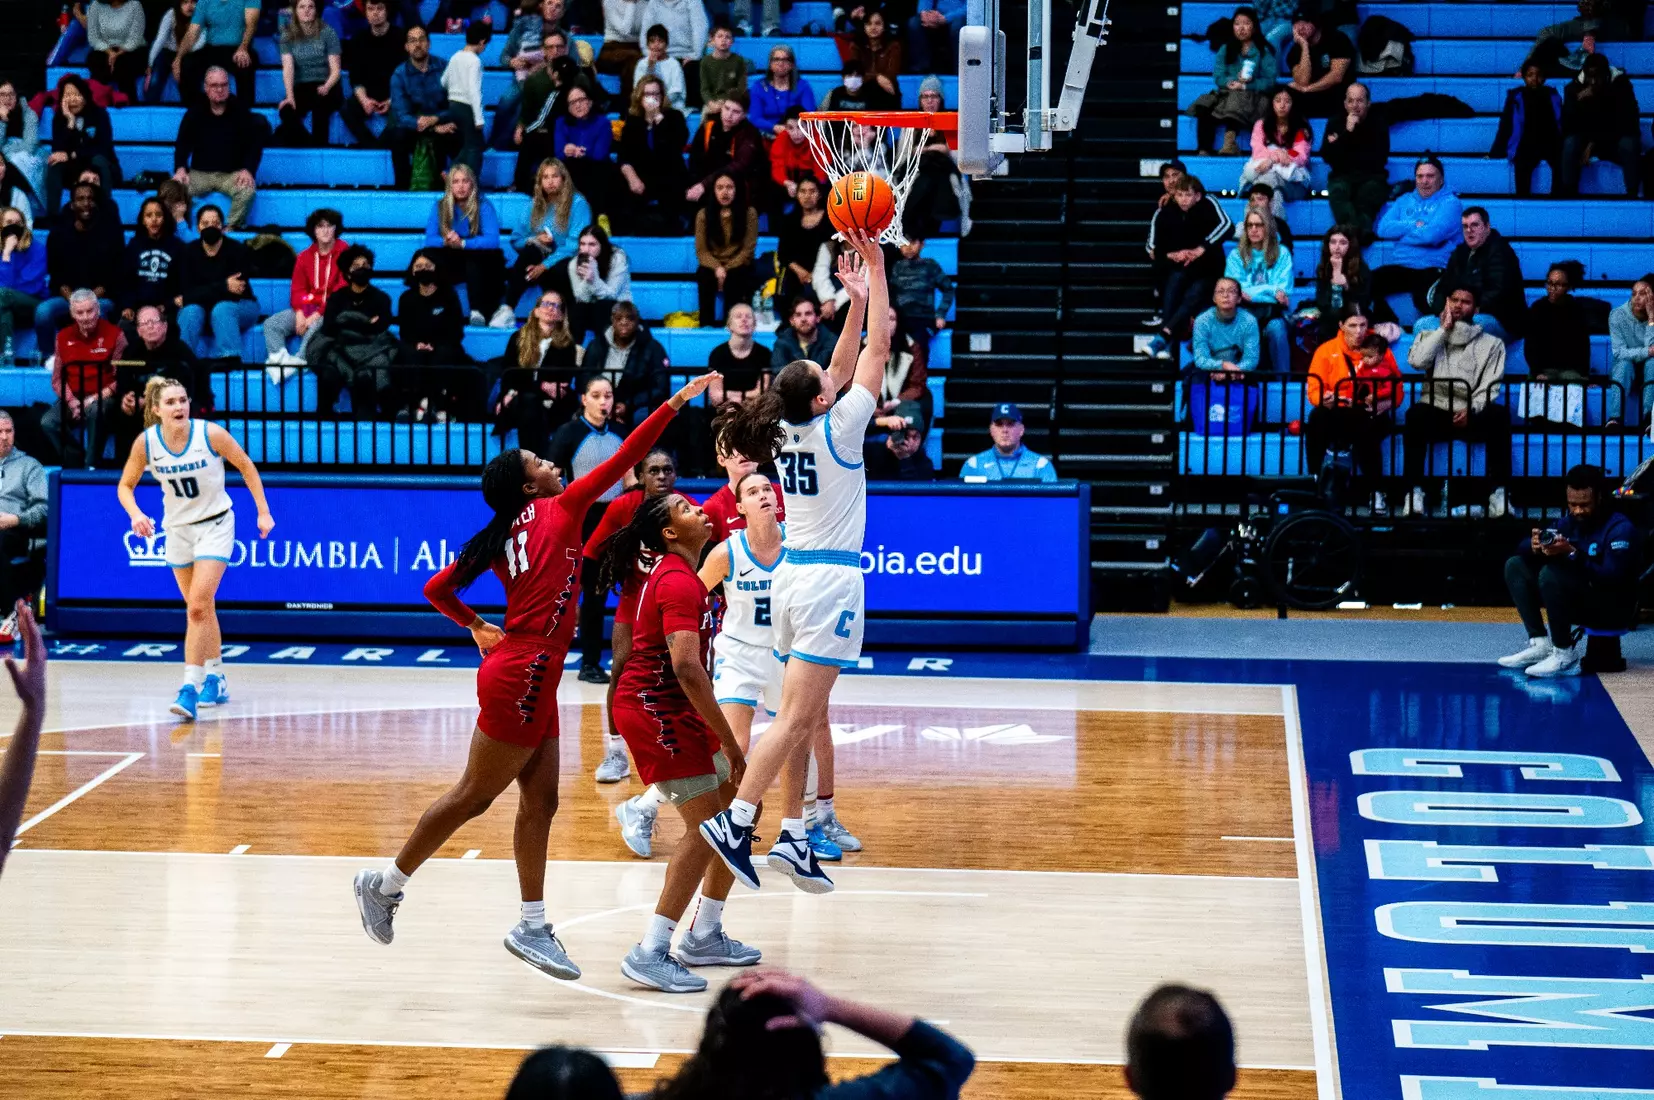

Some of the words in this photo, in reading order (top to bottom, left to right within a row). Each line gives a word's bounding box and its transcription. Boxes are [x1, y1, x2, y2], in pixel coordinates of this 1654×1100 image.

[1000, 404, 1009, 414] C
[155, 459, 208, 473] COLUMBIA
[780, 452, 819, 496] 35
[167, 476, 200, 498] 10
[228, 540, 384, 569] OLUMBIA
[504, 530, 530, 579] 11
[286, 602, 333, 610] DAKTRONICS
[754, 595, 772, 627] 2
[834, 610, 856, 639] C
